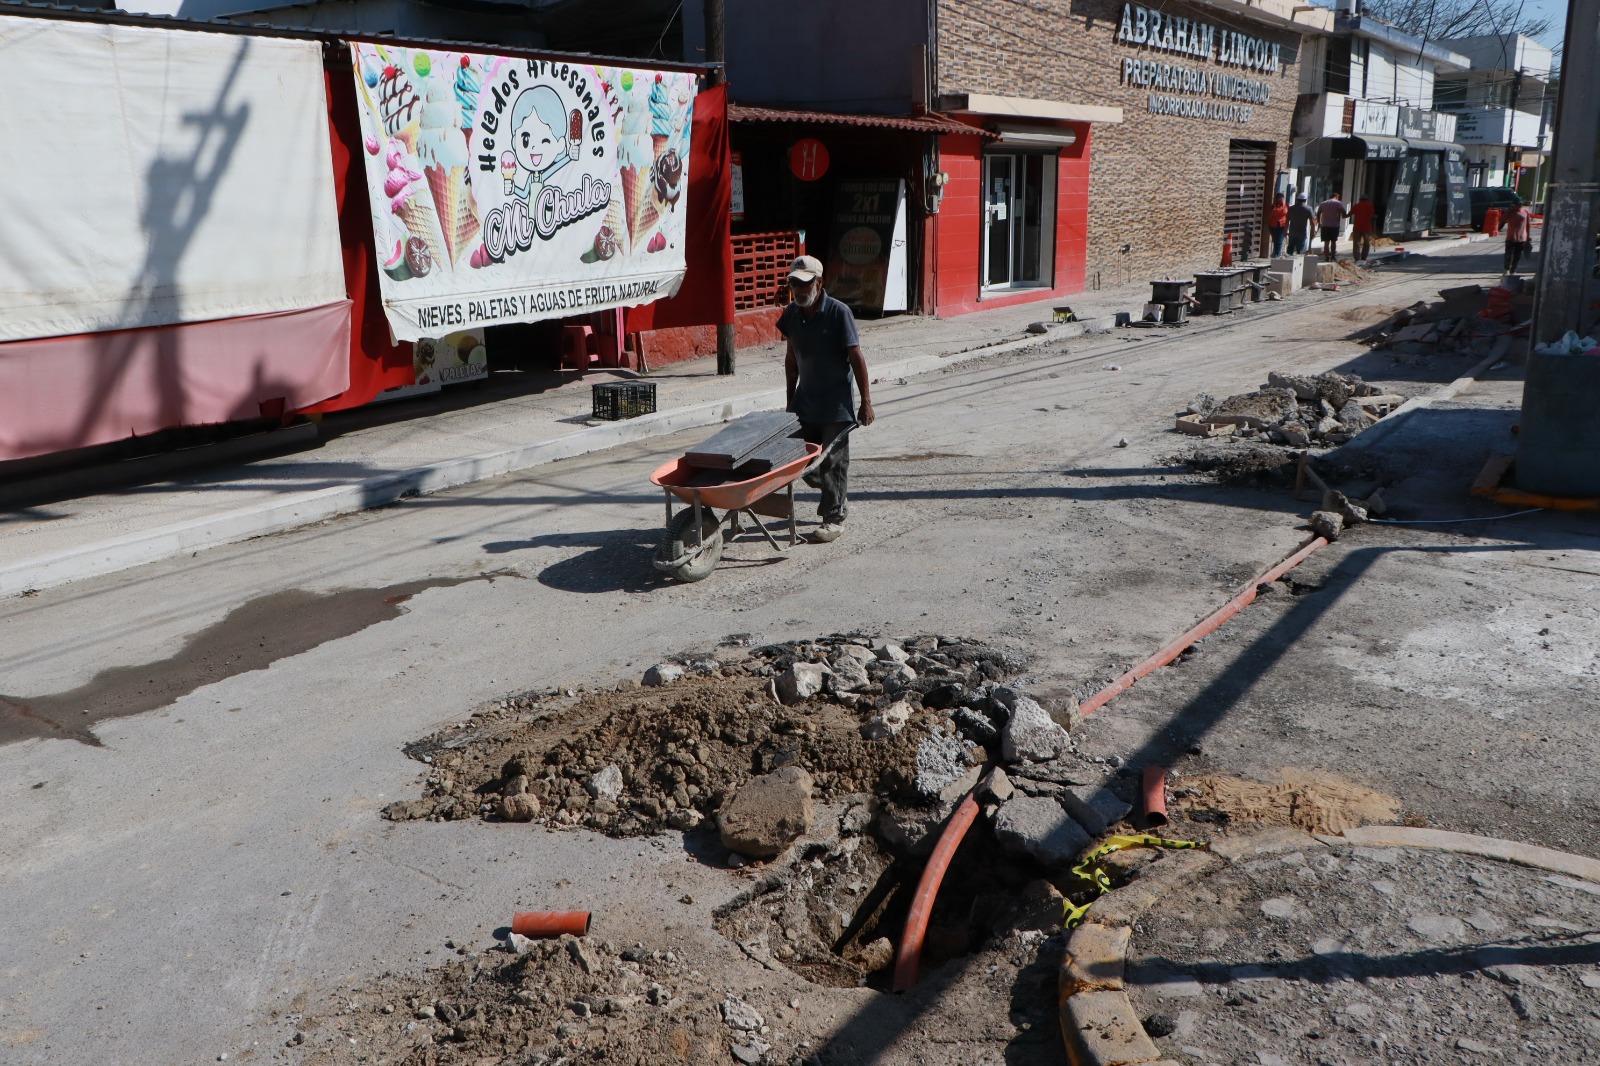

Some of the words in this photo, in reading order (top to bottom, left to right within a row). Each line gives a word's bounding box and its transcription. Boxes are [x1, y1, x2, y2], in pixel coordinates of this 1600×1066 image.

[1119, 3, 1215, 58] ABRAHAM
[1220, 29, 1281, 72] LINCOLN
[1125, 57, 1207, 93] PREPARATORIA
[1206, 72, 1215, 94] Y
[1216, 73, 1271, 101] UNIVERSIDAD
[1149, 94, 1206, 119] INCORPORADA
[841, 182, 864, 193] TODOS
[865, 182, 878, 193] LOS
[484, 199, 535, 263] Mi
[535, 173, 611, 240] Chula
[866, 214, 892, 225] PASTOR
[417, 304, 466, 329] NIEVES,
[469, 296, 518, 323] PALETAS
[518, 296, 527, 314] Y
[530, 290, 567, 313] AGUAS
[568, 288, 583, 309] DE
[584, 285, 617, 306] FRUTA
[619, 280, 659, 300] NATURAL
[443, 363, 482, 380] PALETAS
